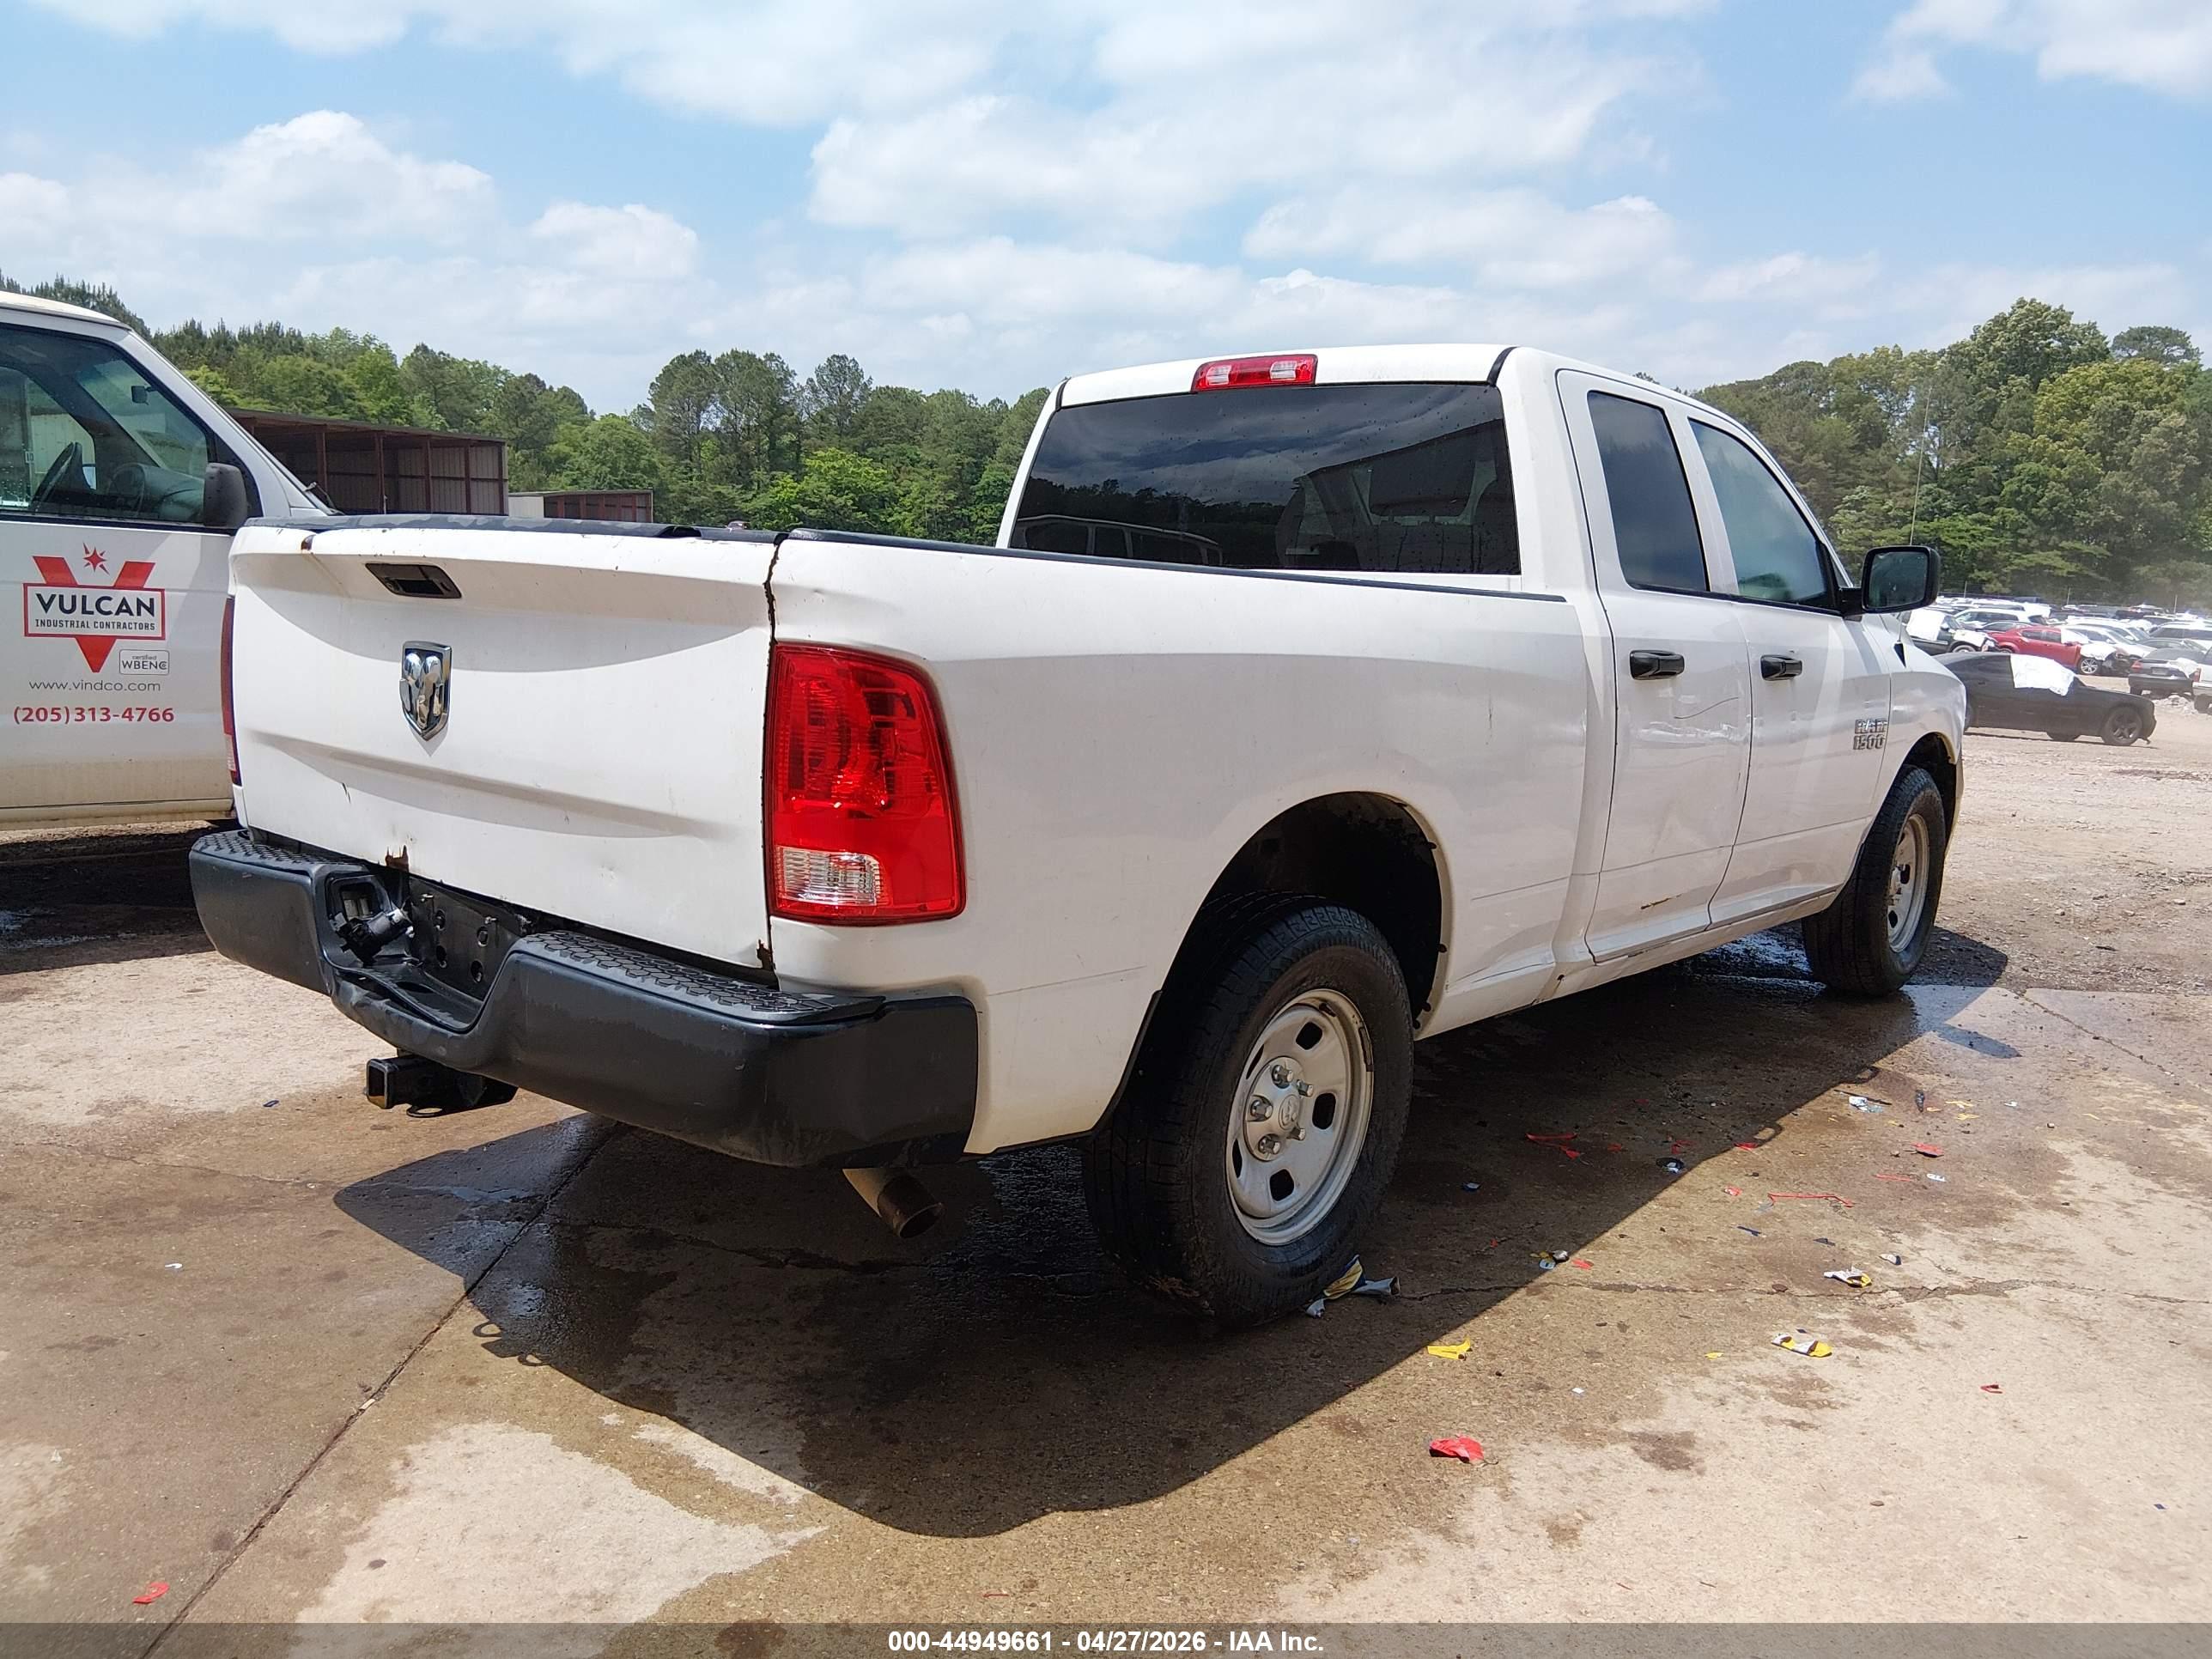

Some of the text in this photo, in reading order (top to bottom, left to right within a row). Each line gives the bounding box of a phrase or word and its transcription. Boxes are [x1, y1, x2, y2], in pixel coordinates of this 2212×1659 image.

[36, 593, 155, 617] VULCAN
[35, 619, 155, 631] INDUSTRIAL CONTRACTORS
[122, 660, 167, 670] WBENC
[28, 680, 161, 691] www.vindco.com
[1853, 734, 1885, 750] 1500
